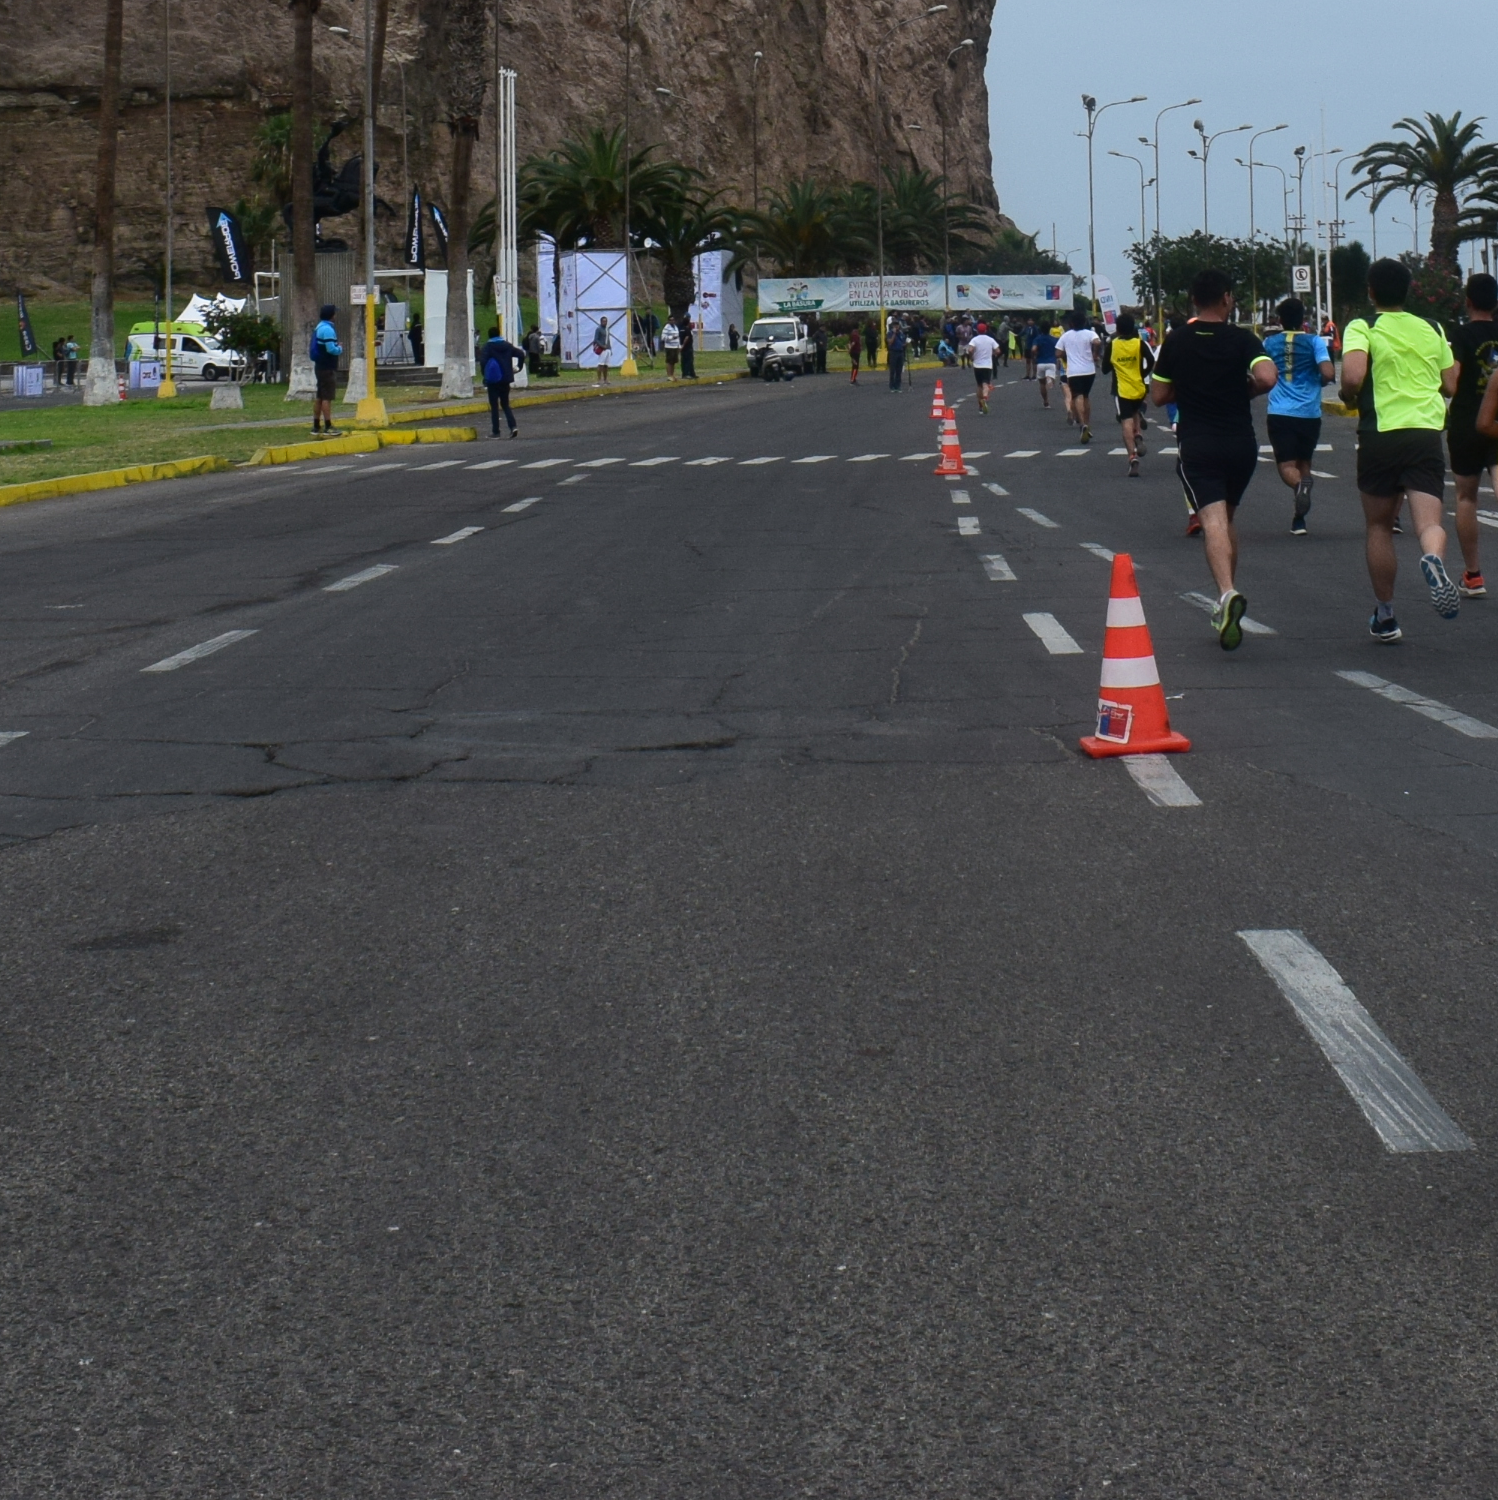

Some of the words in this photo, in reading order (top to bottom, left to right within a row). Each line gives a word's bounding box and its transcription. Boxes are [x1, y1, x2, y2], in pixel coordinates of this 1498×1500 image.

[893, 280, 928, 288] RESIDUOS
[849, 290, 860, 298] EN
[863, 290, 873, 298] LA
[875, 289, 890, 298] VA
